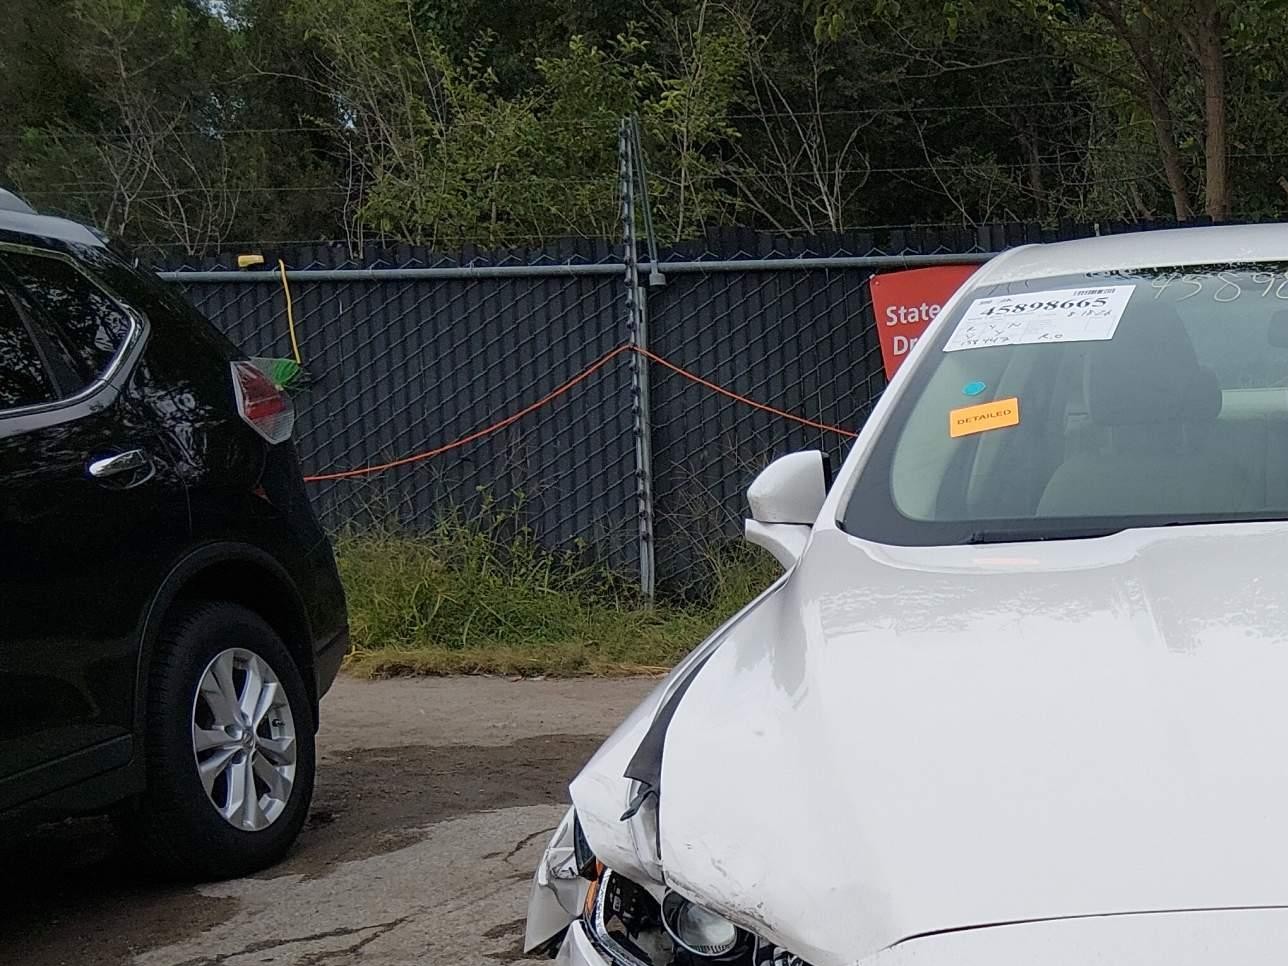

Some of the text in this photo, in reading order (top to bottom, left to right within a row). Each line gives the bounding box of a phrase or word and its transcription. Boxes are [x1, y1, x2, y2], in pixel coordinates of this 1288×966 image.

[886, 302, 941, 327] State
[980, 297, 1109, 316] 45898665
[957, 409, 1012, 425] DETAILED
